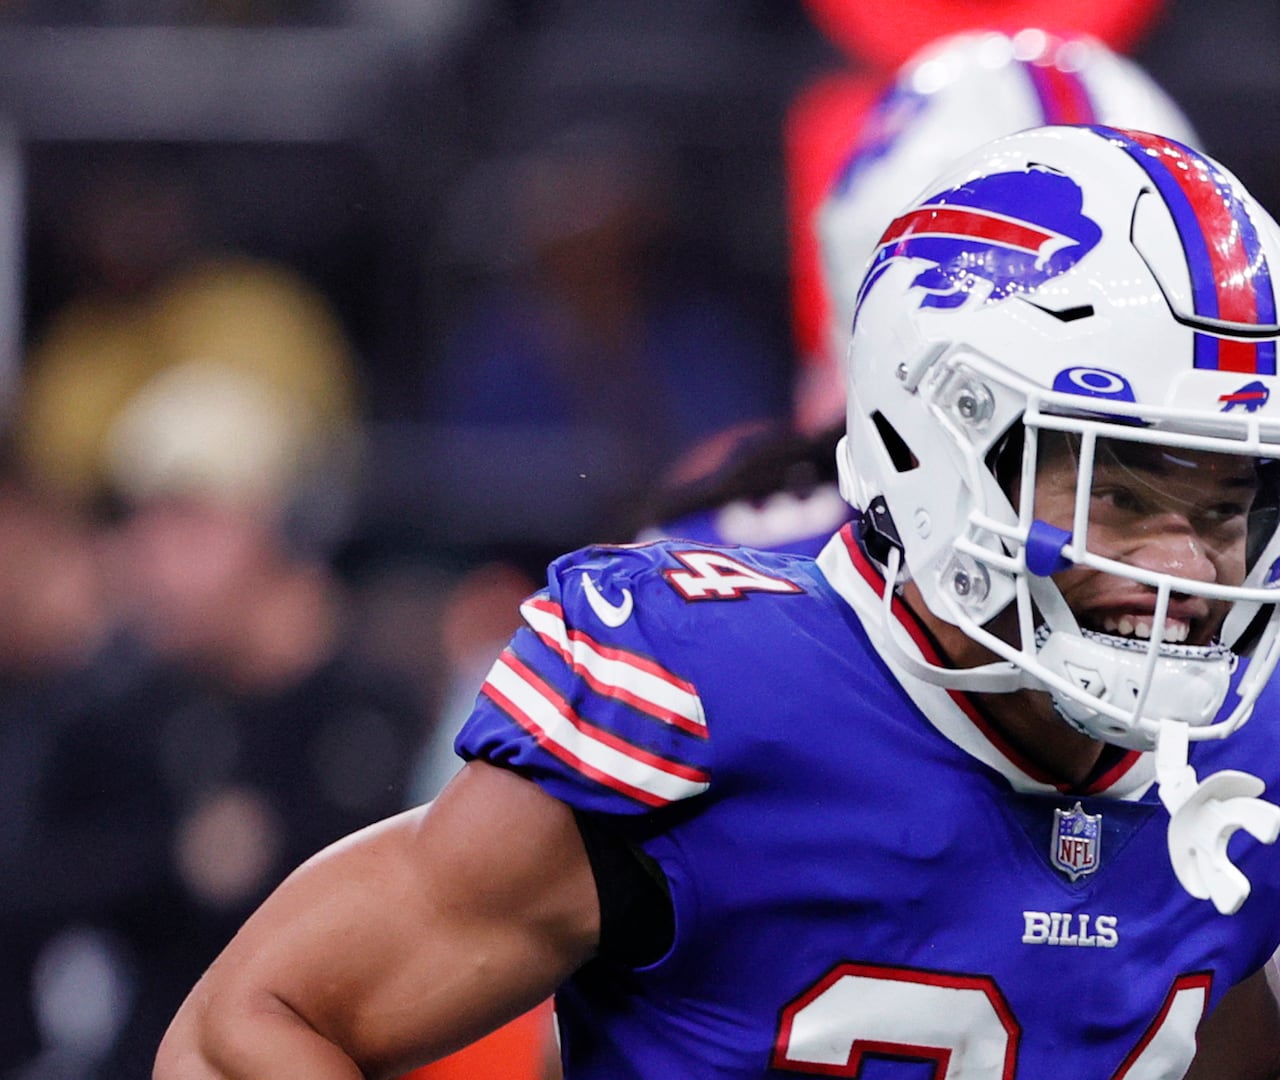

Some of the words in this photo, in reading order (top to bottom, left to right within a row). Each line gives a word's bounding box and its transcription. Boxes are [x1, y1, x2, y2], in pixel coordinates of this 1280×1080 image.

[632, 541, 808, 604] 4
[1060, 838, 1093, 868] NFL
[1021, 911, 1119, 948] BILLS
